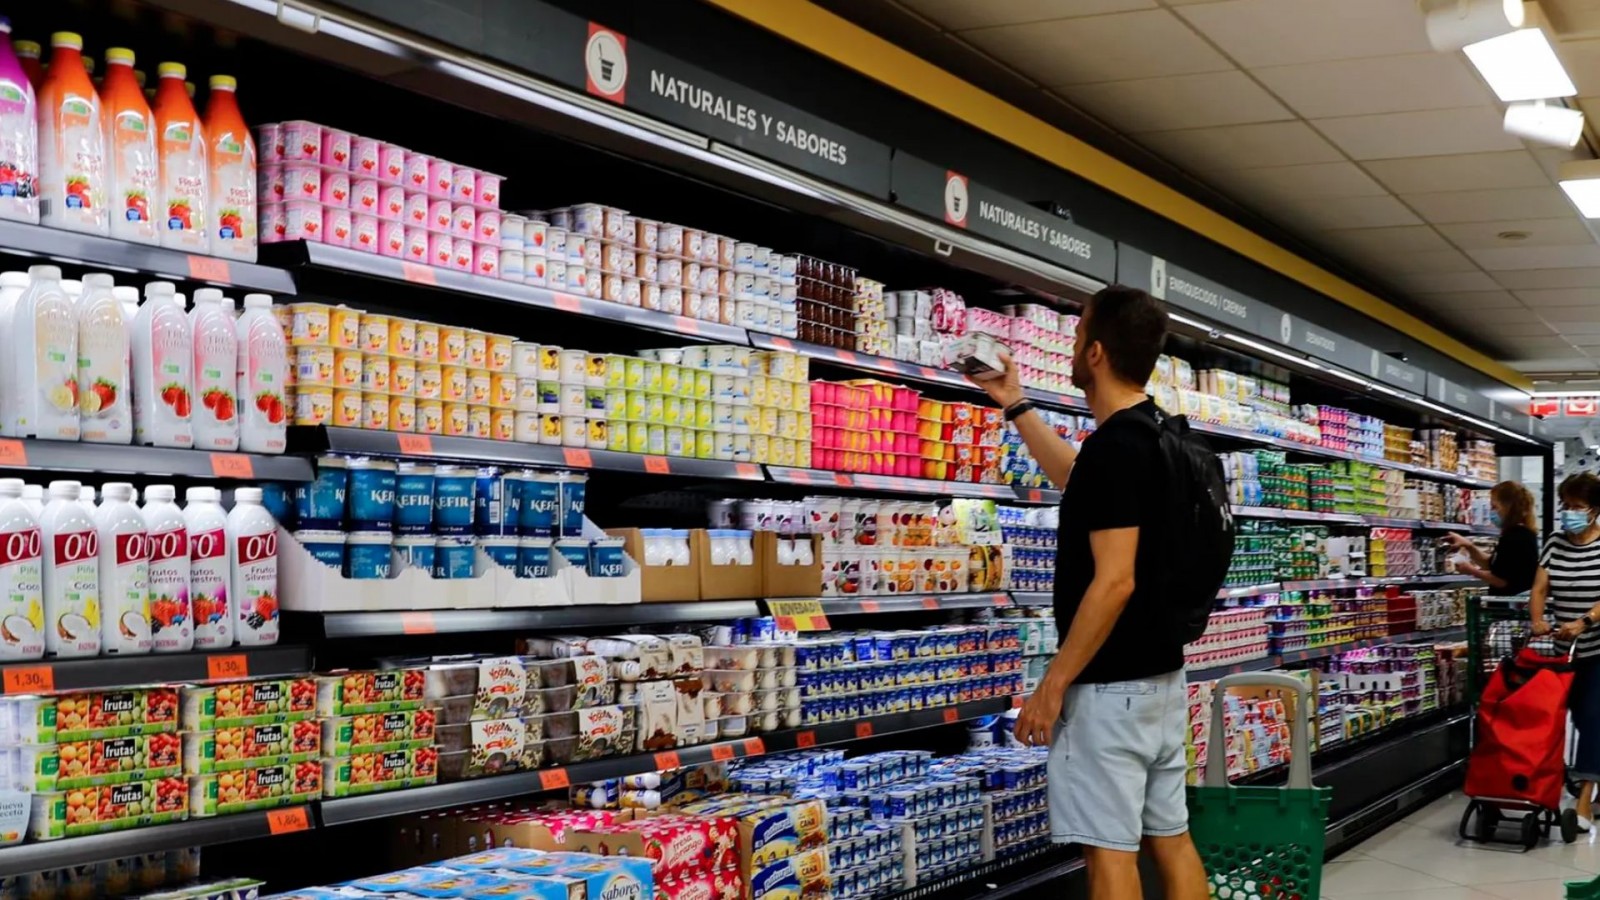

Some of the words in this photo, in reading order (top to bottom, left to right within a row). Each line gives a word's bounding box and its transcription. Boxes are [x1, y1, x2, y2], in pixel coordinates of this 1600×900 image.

[651, 70, 757, 132] NATURALES
[761, 114, 773, 136] Y
[777, 120, 847, 165] SABORES
[980, 201, 1040, 239] NATURALES
[1041, 225, 1049, 242] Y
[1050, 229, 1092, 260] SABORES
[375, 679, 395, 689] frutas
[254, 689, 280, 700] frutas
[104, 700, 133, 711] frutas
[384, 719, 405, 729] frutas
[256, 731, 281, 743] frutas
[105, 746, 134, 758] frutas
[383, 757, 405, 768] frutas
[258, 773, 283, 785] frutas
[113, 790, 142, 803] frutas
[763, 817, 793, 842] natural
[673, 834, 693, 852] fresa
[763, 865, 795, 891] natural
[601, 883, 640, 900] sabores
